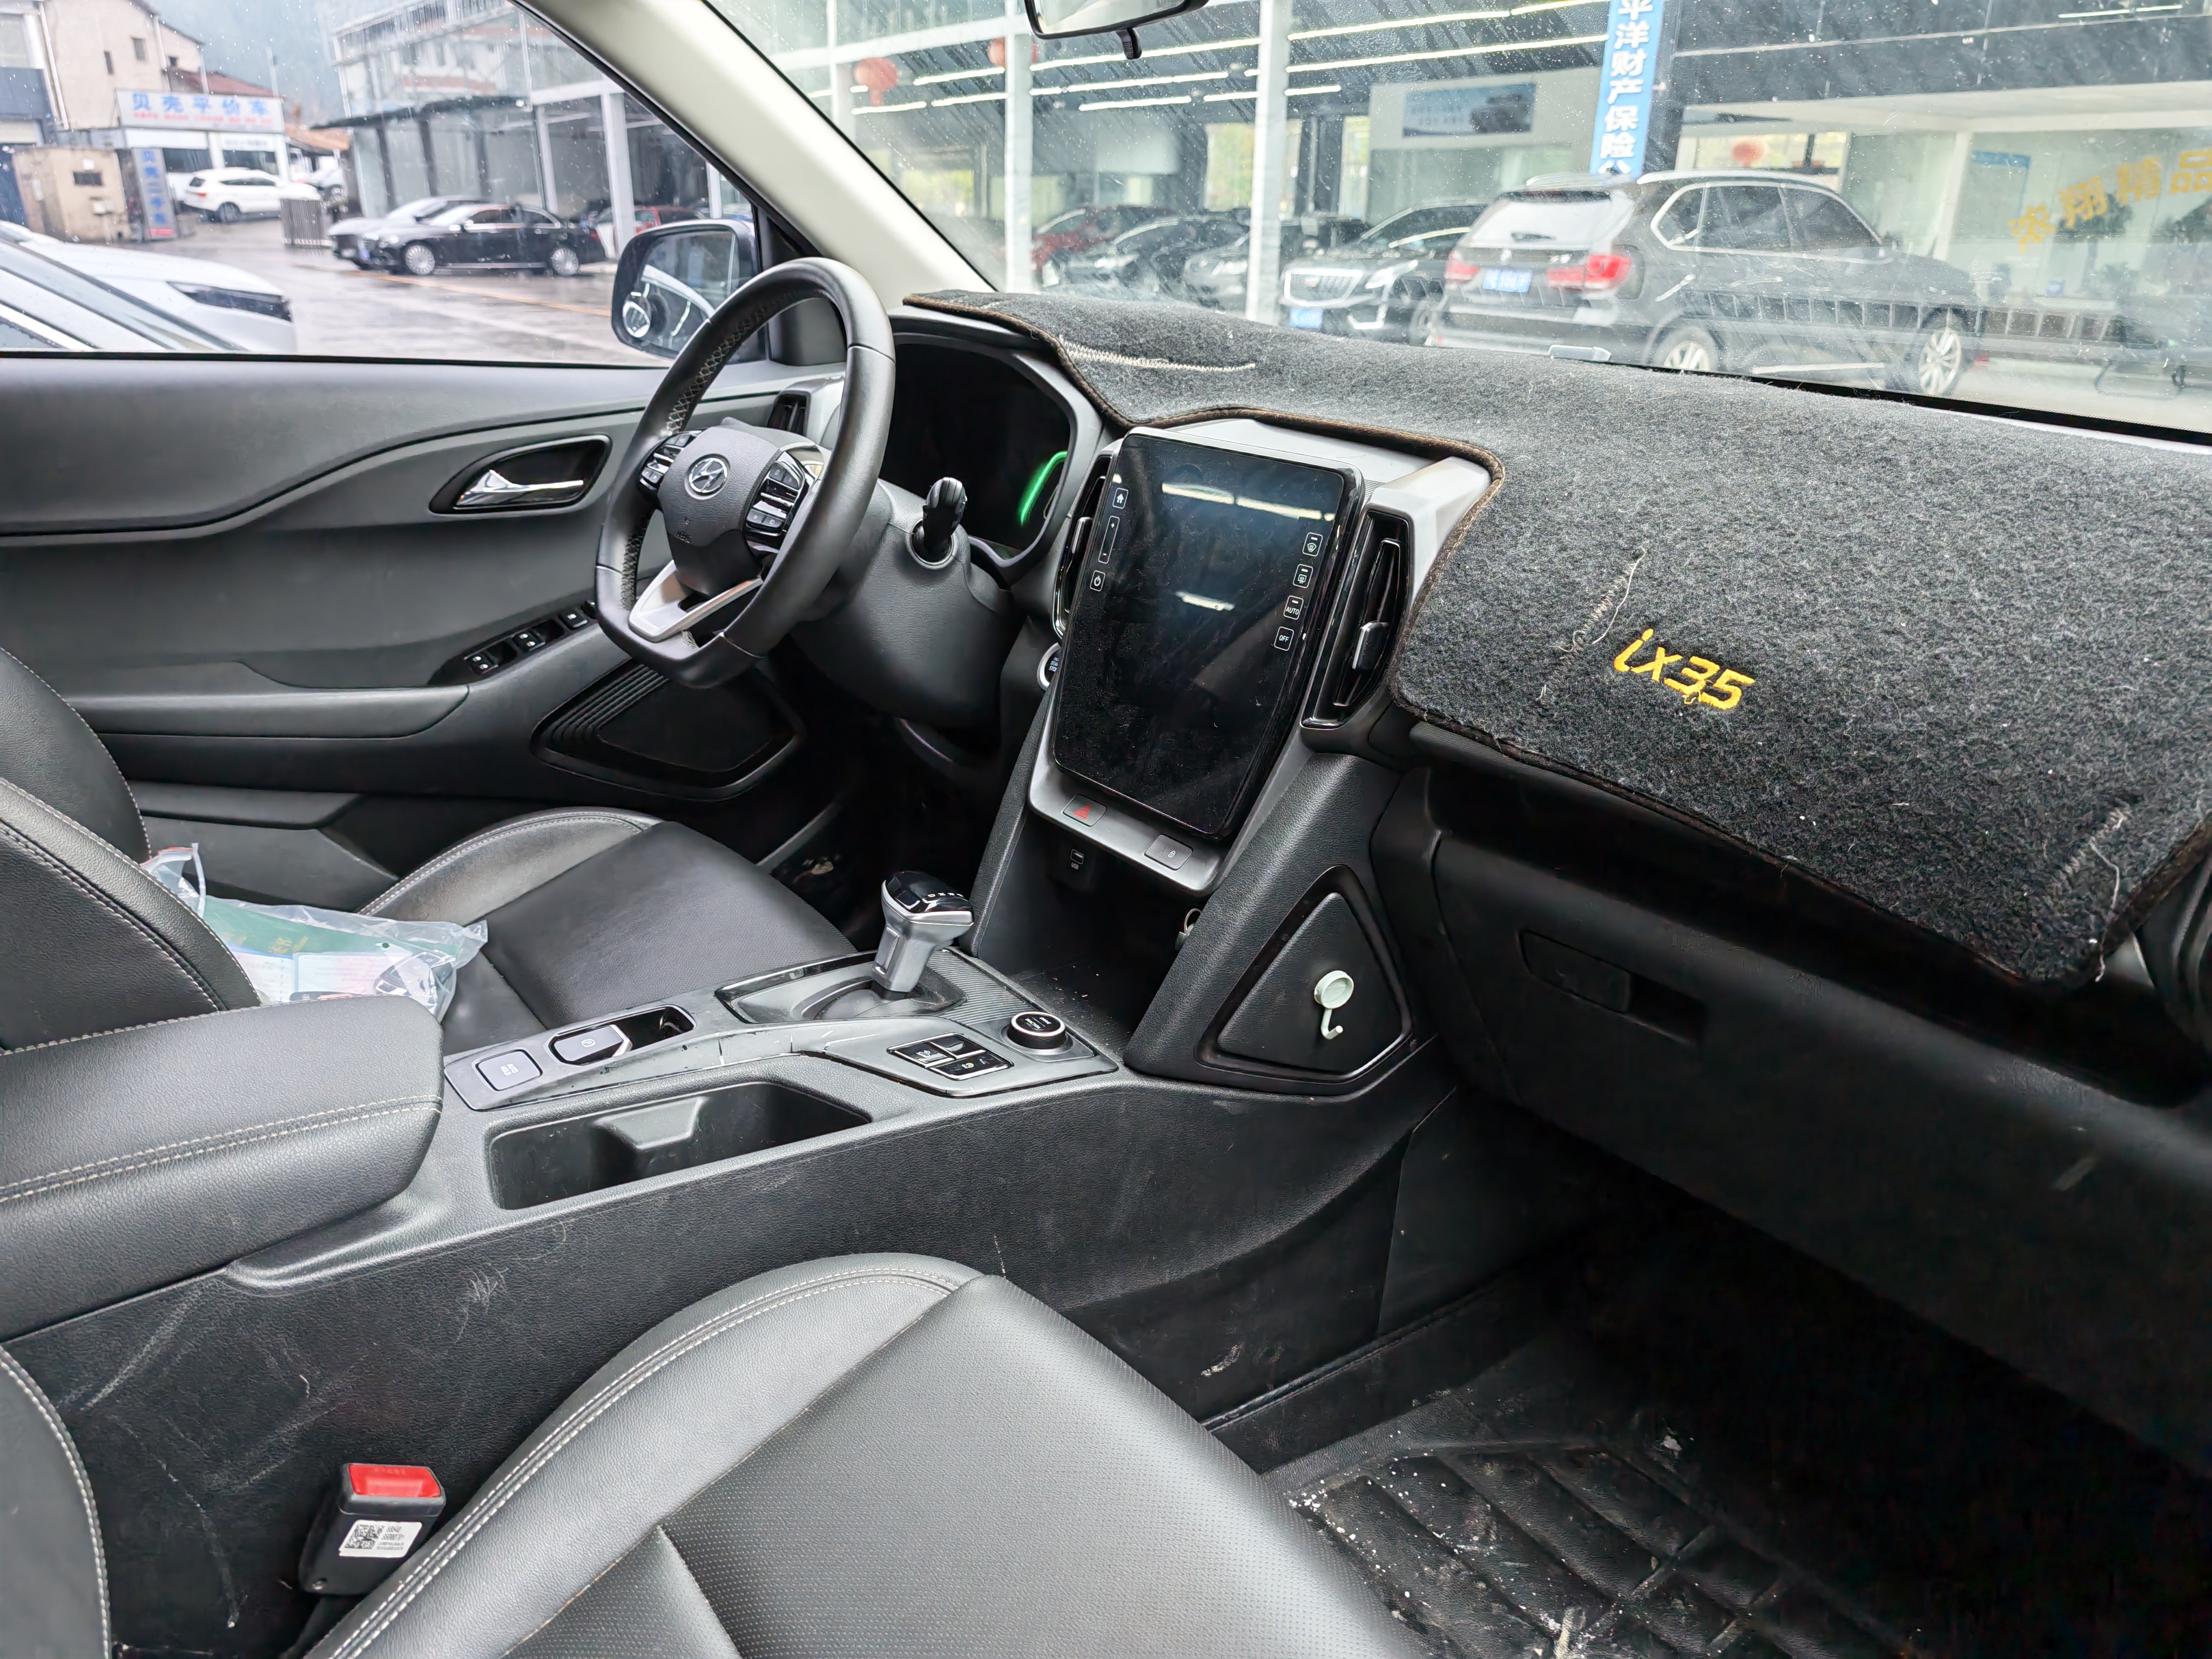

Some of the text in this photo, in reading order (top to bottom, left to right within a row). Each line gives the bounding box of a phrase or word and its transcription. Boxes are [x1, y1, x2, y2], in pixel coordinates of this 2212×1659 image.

[1285, 606, 1299, 615] AUTO
[1279, 635, 1290, 643] OFF
[1071, 862, 1079, 870] USB
[500, 1065, 512, 1076] HOLD
[507, 1063, 519, 1074] AUTO
